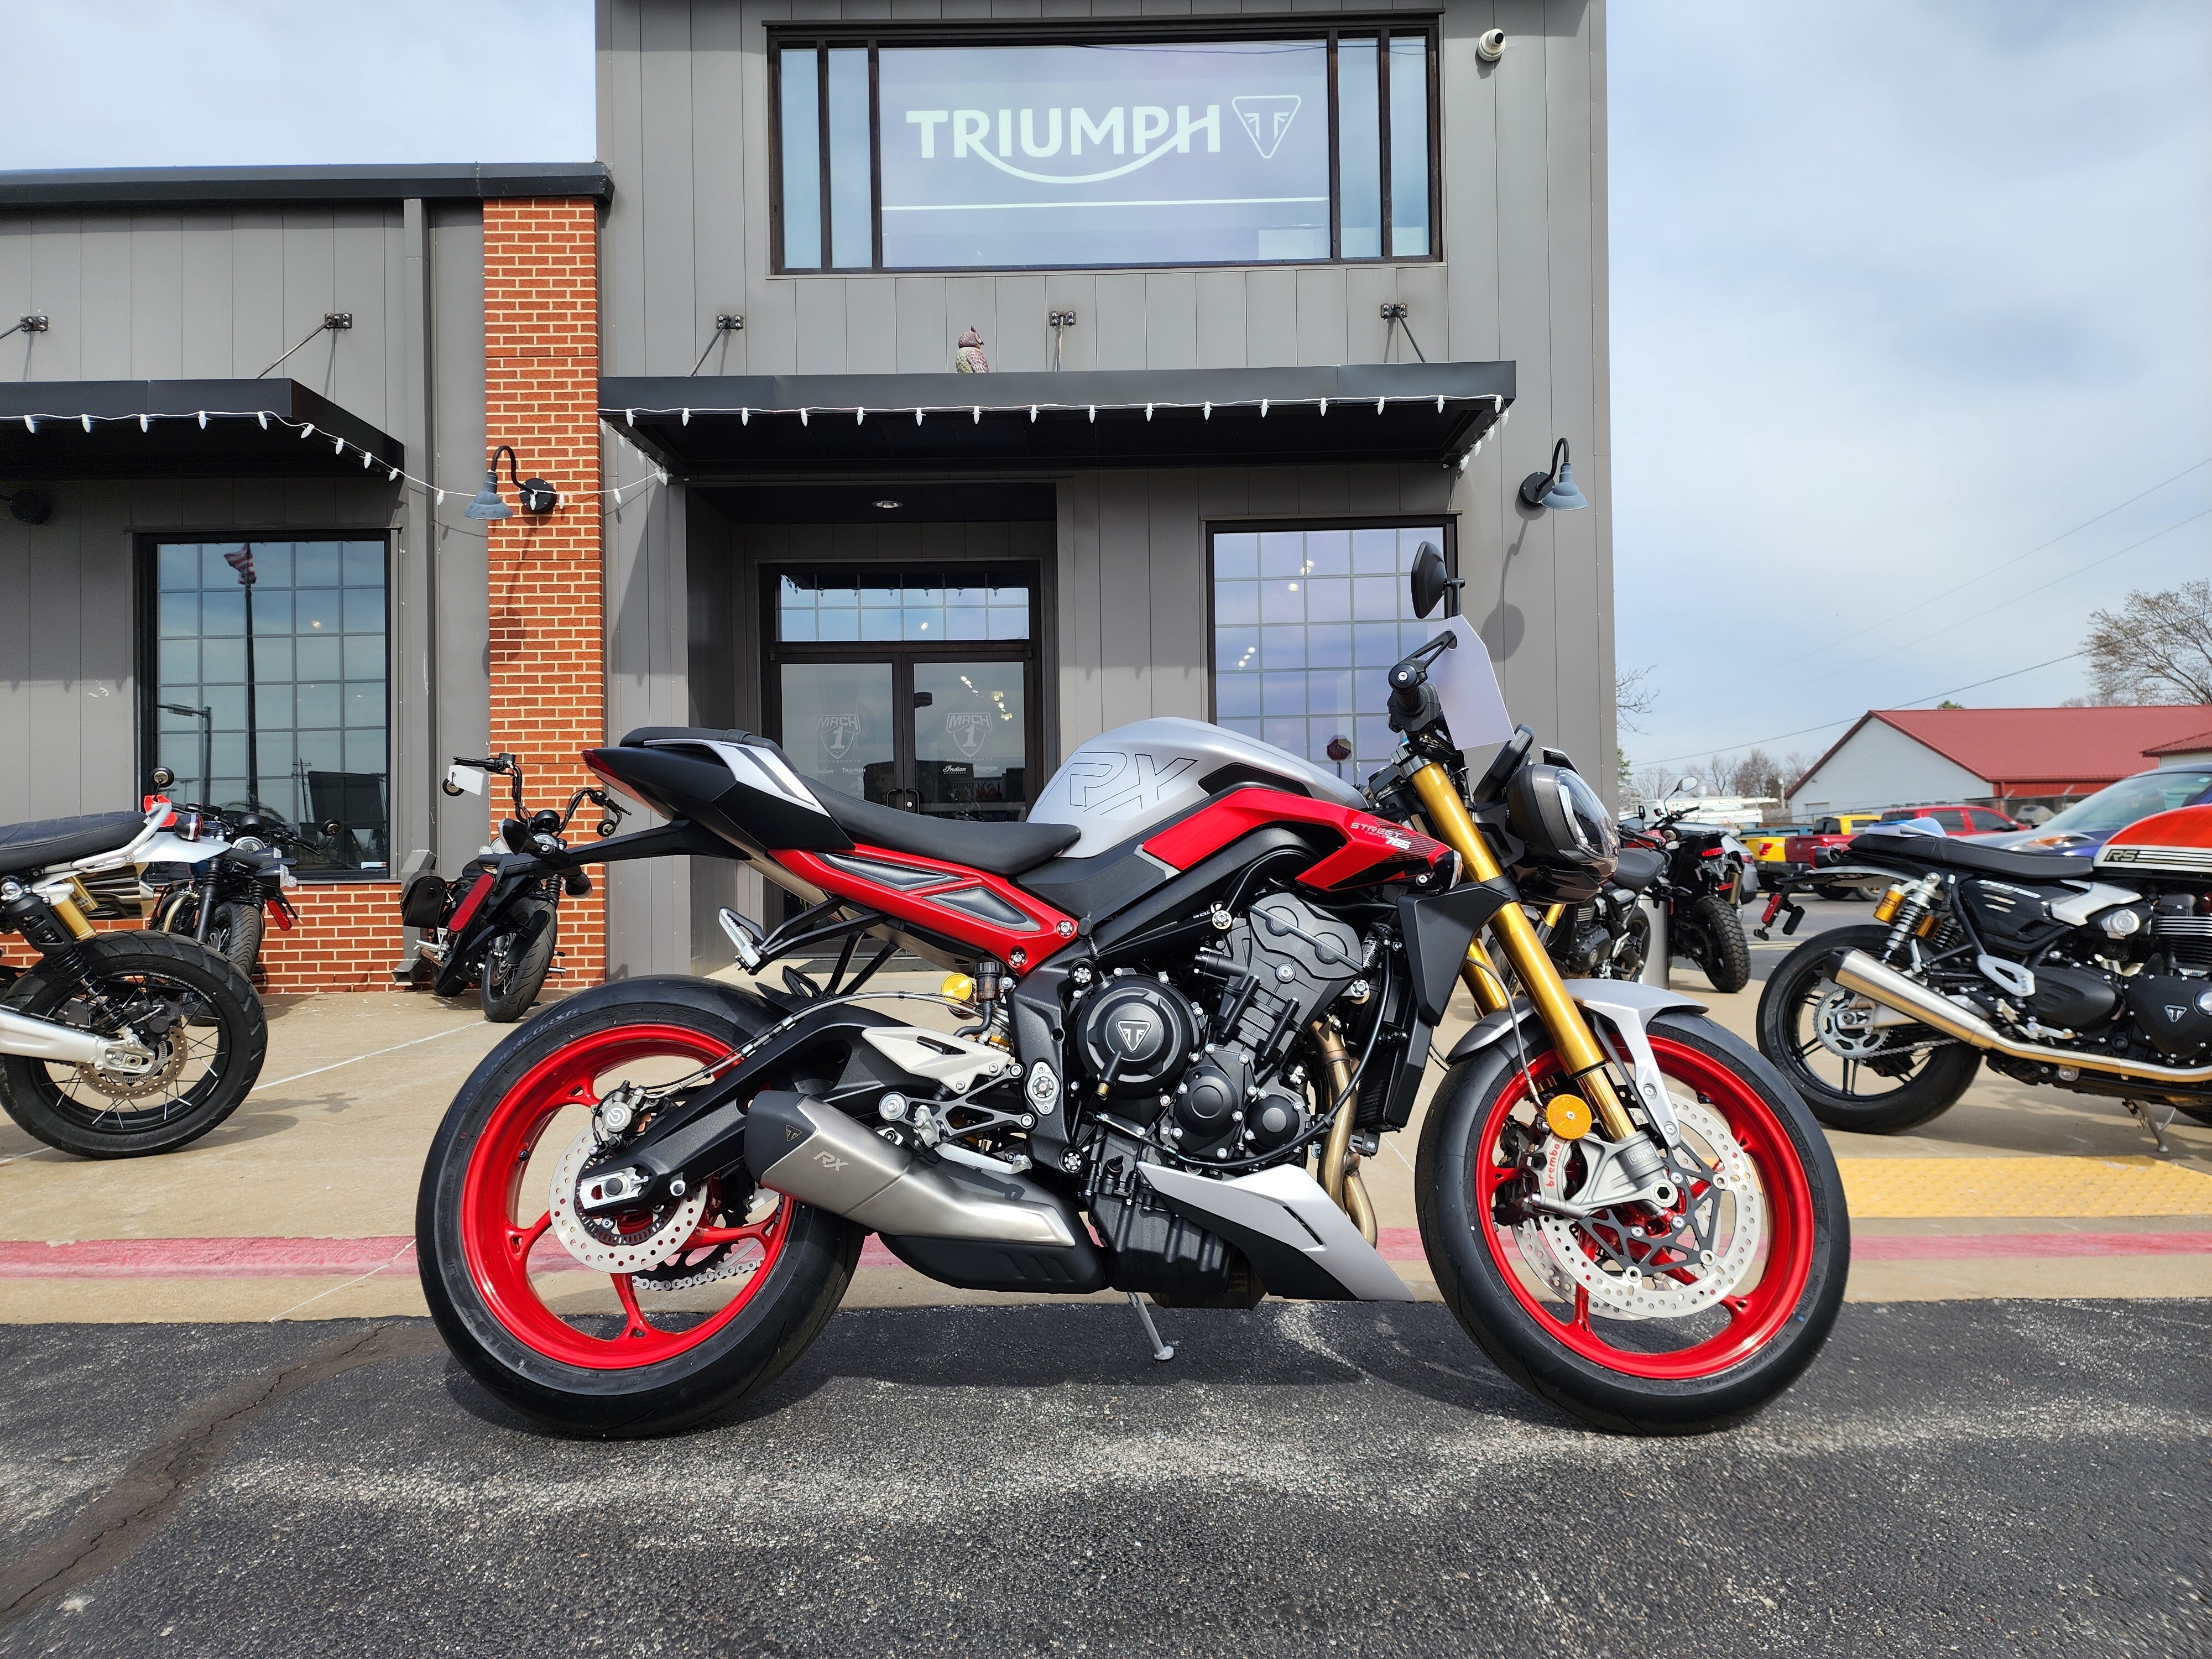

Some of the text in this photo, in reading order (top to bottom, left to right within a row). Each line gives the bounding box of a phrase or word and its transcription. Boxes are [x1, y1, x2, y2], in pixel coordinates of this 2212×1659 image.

[906, 105, 1220, 183] TRIUMPH
[816, 716, 859, 731] MACH
[948, 714, 990, 729] MACH
[830, 726, 845, 749] 1
[963, 724, 977, 747] 1
[1037, 752, 1198, 815] RX
[1350, 822, 1402, 838] STREET
[1385, 836, 1412, 849] 765
[2105, 849, 2138, 862] RS
[477, 1008, 580, 1087] SUPERCORSA
[813, 1151, 849, 1171] RX
[1629, 1146, 1655, 1162] ÖHLINS
[1546, 1143, 1561, 1188] brembo
